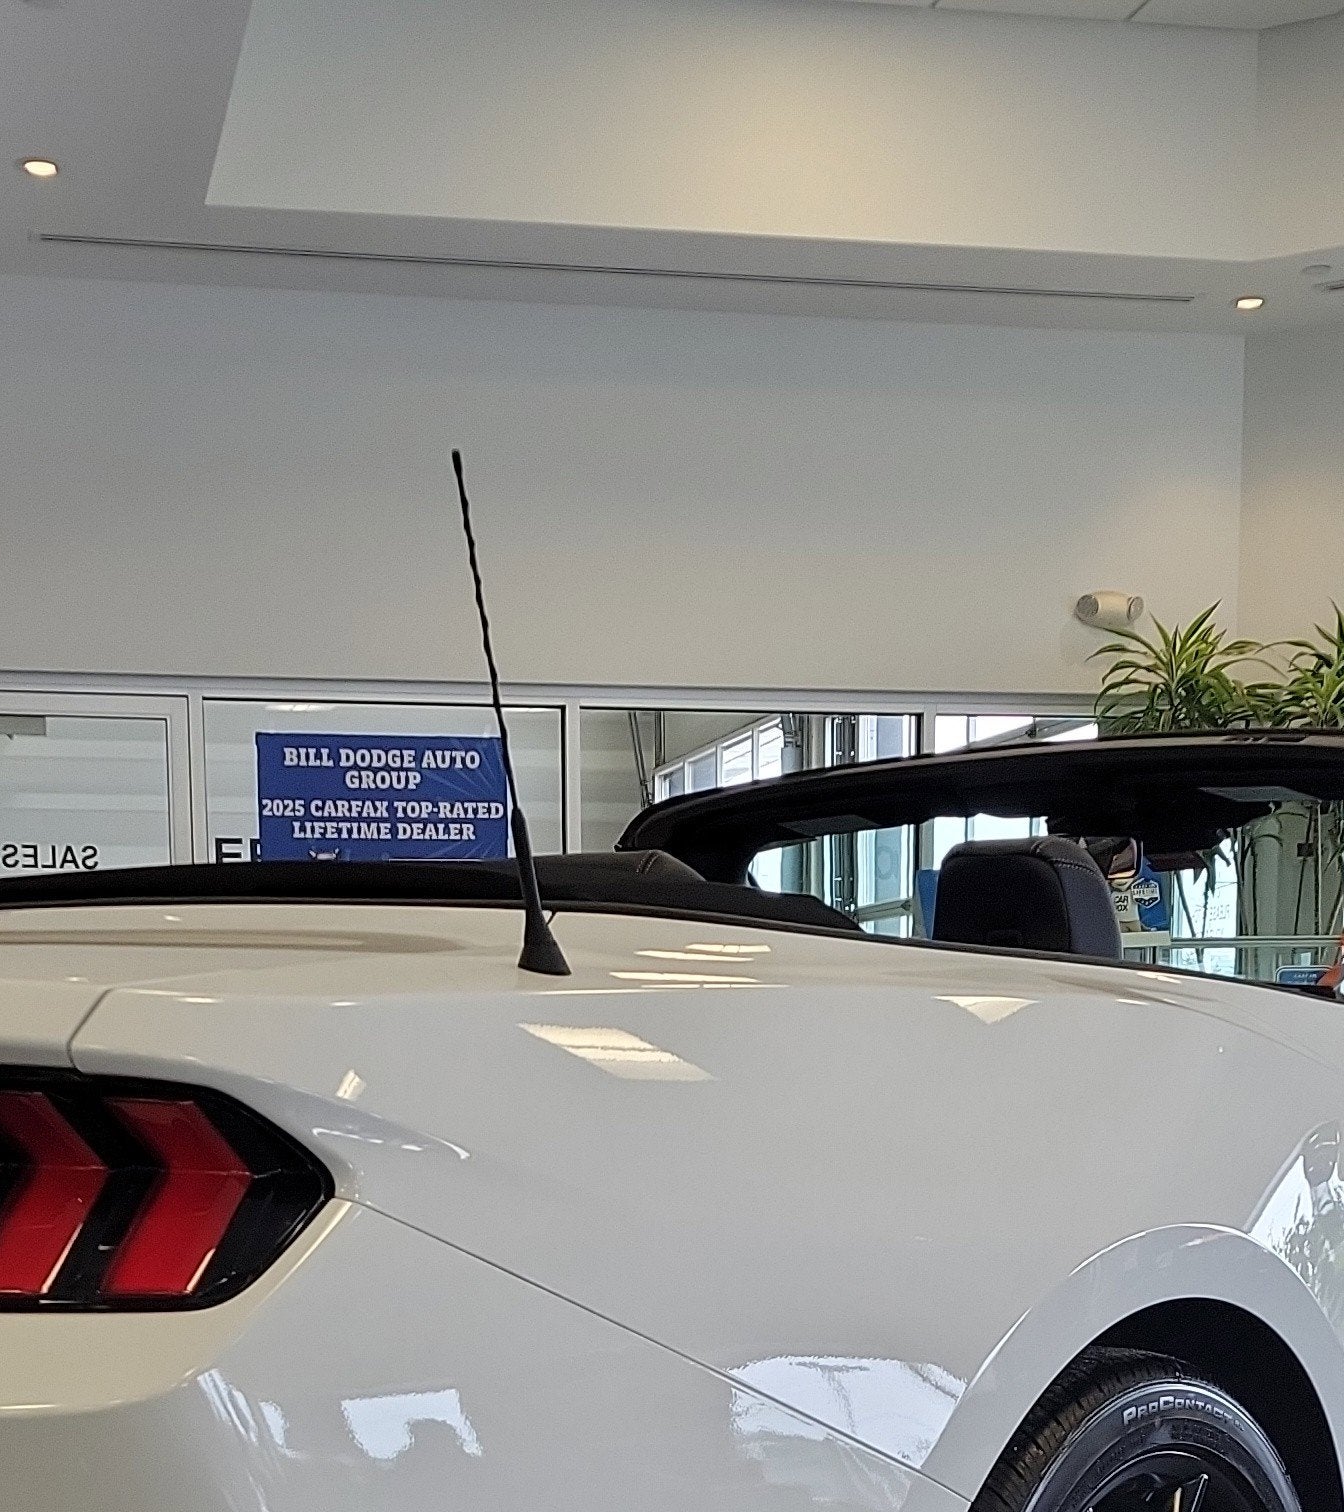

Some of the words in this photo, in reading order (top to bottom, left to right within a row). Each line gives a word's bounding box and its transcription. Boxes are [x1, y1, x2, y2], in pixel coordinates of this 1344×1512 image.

[283, 748, 334, 767] BILL
[339, 748, 416, 768] DODGE
[421, 750, 481, 770] AUTO
[345, 771, 422, 790] GROUP
[262, 799, 306, 817] 2025
[310, 800, 389, 818] CARFAX
[393, 801, 504, 819] TOP-RATED
[292, 821, 392, 839] LIFETIME
[397, 823, 476, 841] DEALER
